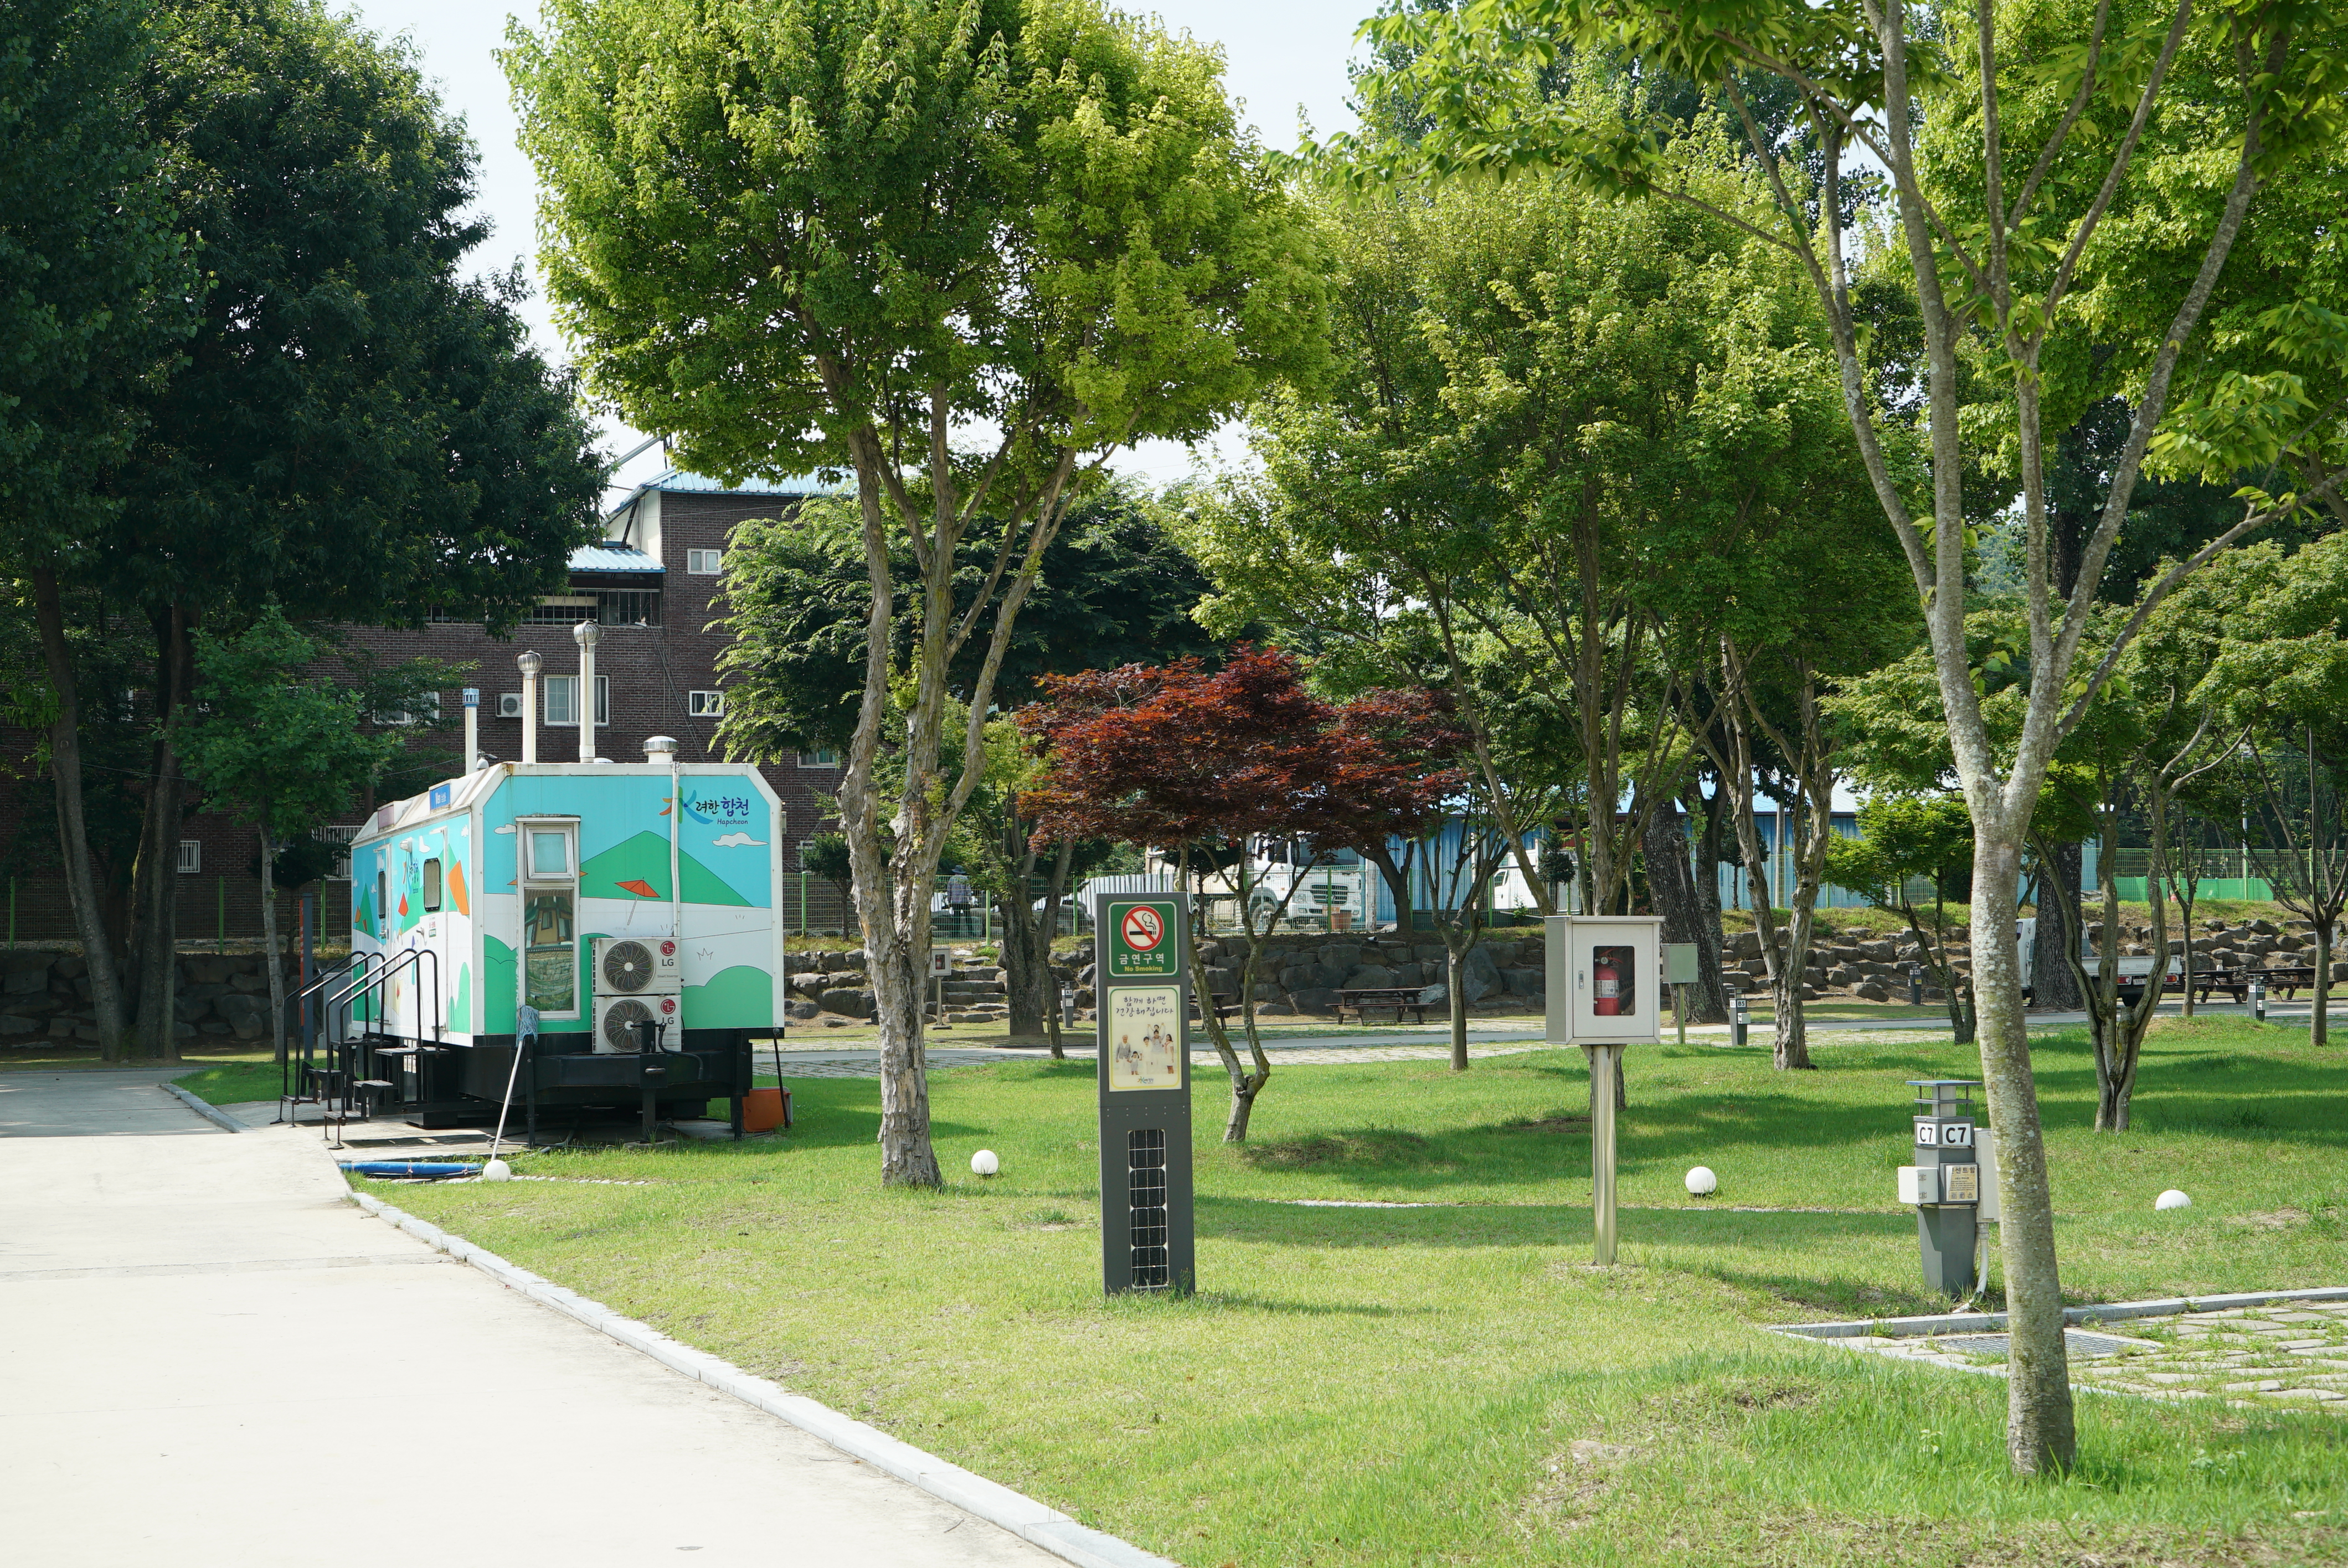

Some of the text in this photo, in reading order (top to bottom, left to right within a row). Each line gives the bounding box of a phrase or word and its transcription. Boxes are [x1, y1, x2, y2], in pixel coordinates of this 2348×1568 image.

[720, 796, 749, 817] 합천
[717, 818, 748, 827] Hapcheon
[662, 958, 674, 967] LG
[1119, 953, 1164, 965] 금연구역
[1124, 996, 1166, 1007] 함께 하면
[1116, 1007, 1174, 1017] 건강해집니다
[1920, 1126, 1933, 1142] C7
[1945, 1127, 1966, 1143] C7
